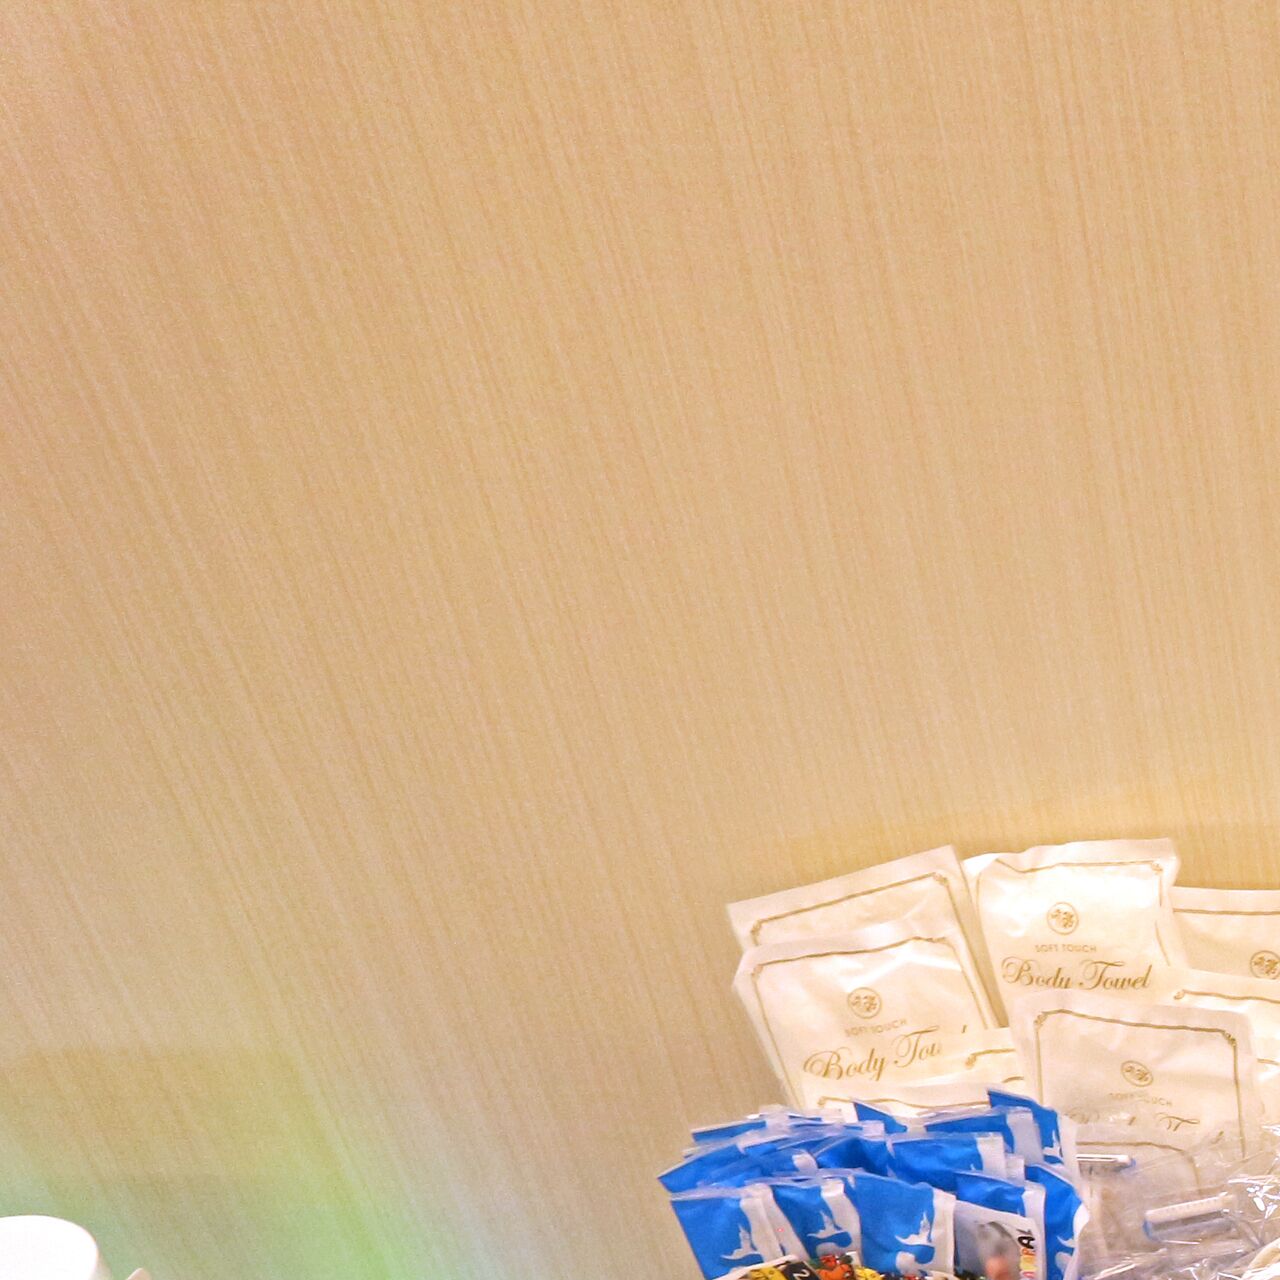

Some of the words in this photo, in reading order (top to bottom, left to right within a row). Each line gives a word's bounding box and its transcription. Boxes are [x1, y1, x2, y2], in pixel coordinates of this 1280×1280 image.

[1002, 955, 1073, 990] Body
[1078, 959, 1153, 990] Towel
[803, 1046, 886, 1082] Body
[891, 1024, 967, 1069] Tow
